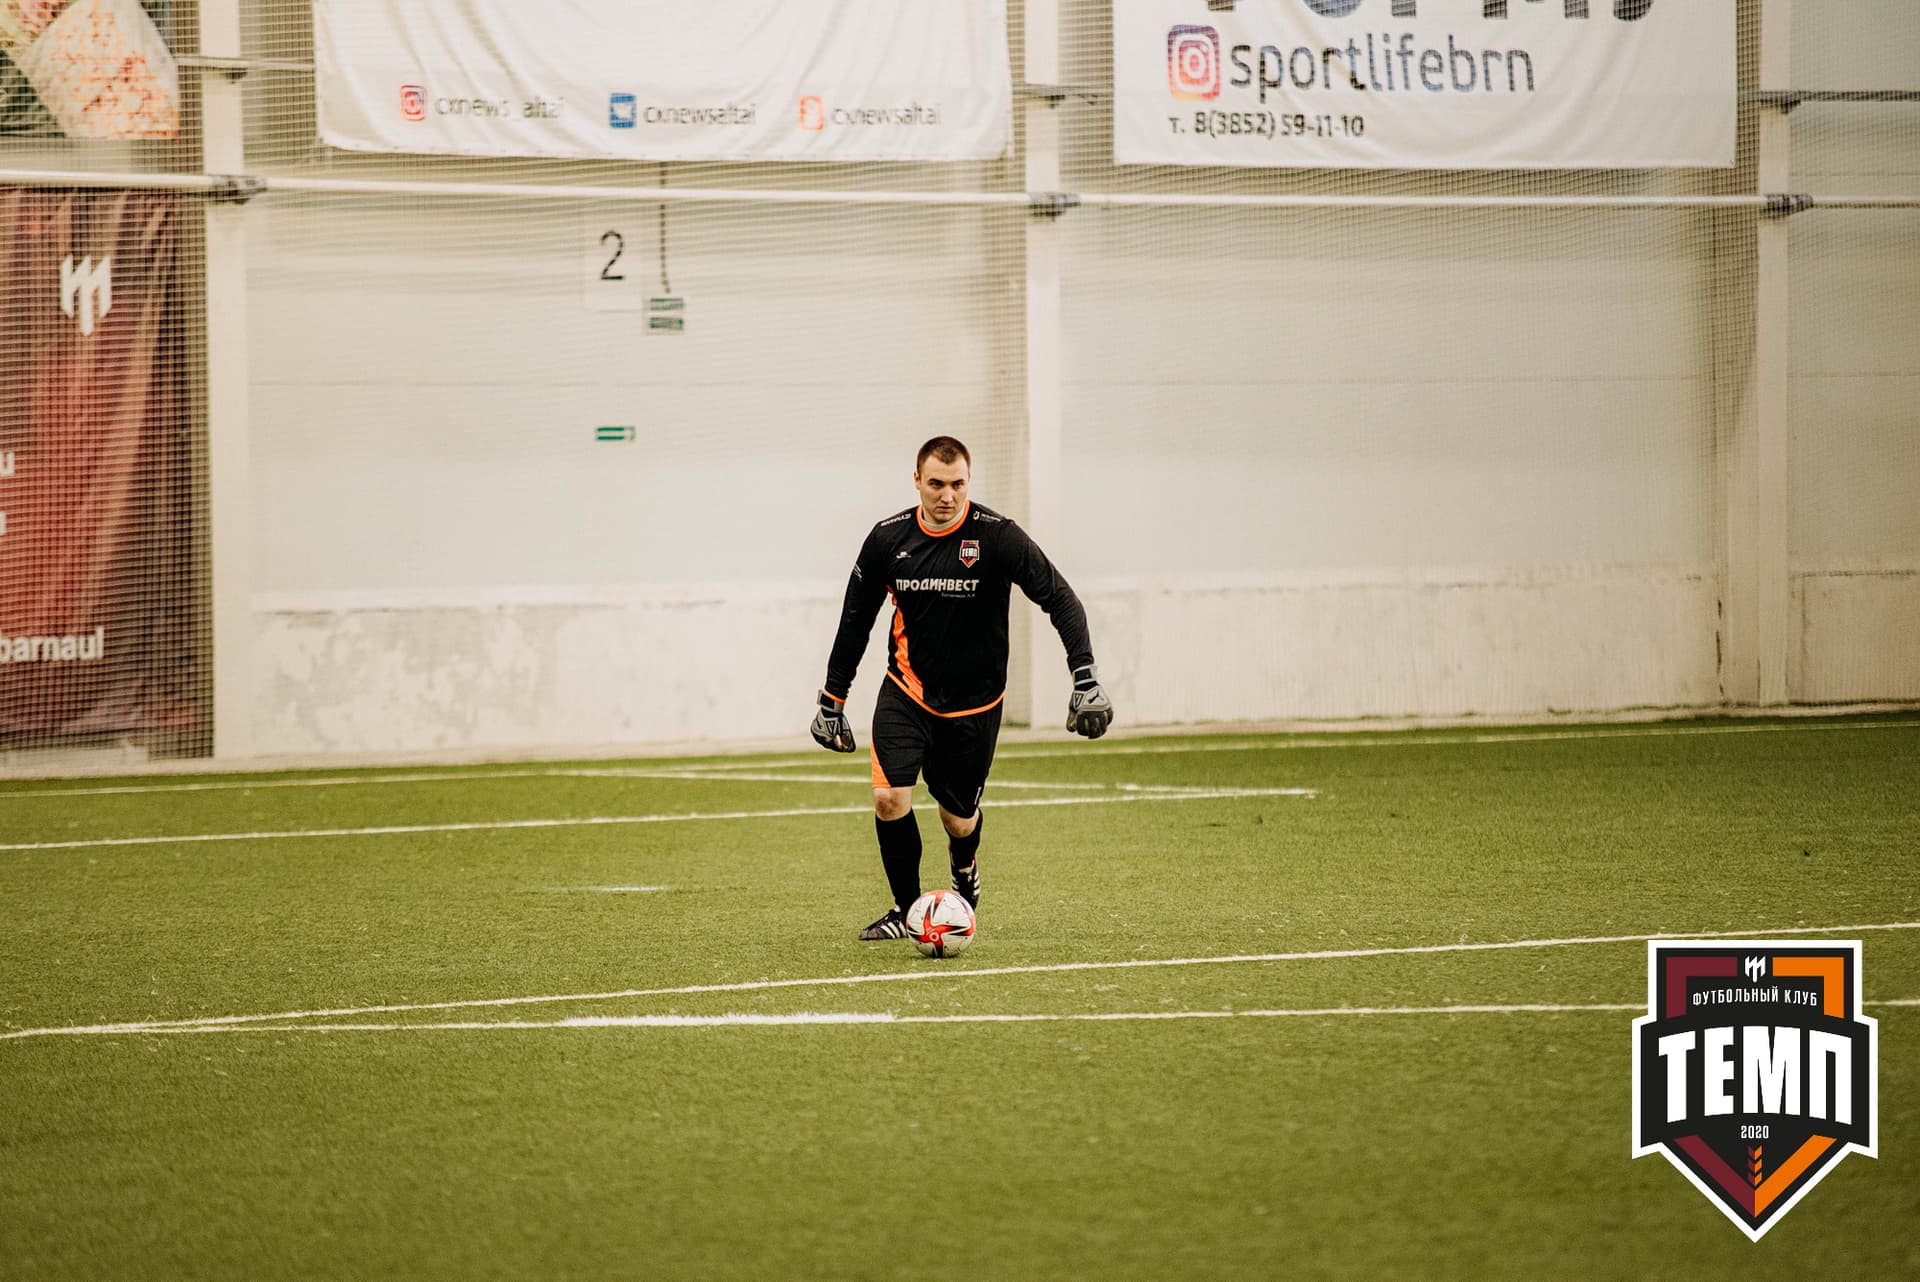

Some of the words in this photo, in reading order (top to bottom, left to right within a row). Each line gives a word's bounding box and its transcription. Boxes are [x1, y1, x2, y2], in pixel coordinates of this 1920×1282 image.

[1230, 31, 1536, 102] sportlifebrn
[1194, 110, 1275, 140] 8(3852)
[1280, 113, 1365, 137] 59-11-10
[600, 229, 626, 281] 2
[895, 578, 980, 592] ПРОДИНВЕСТ
